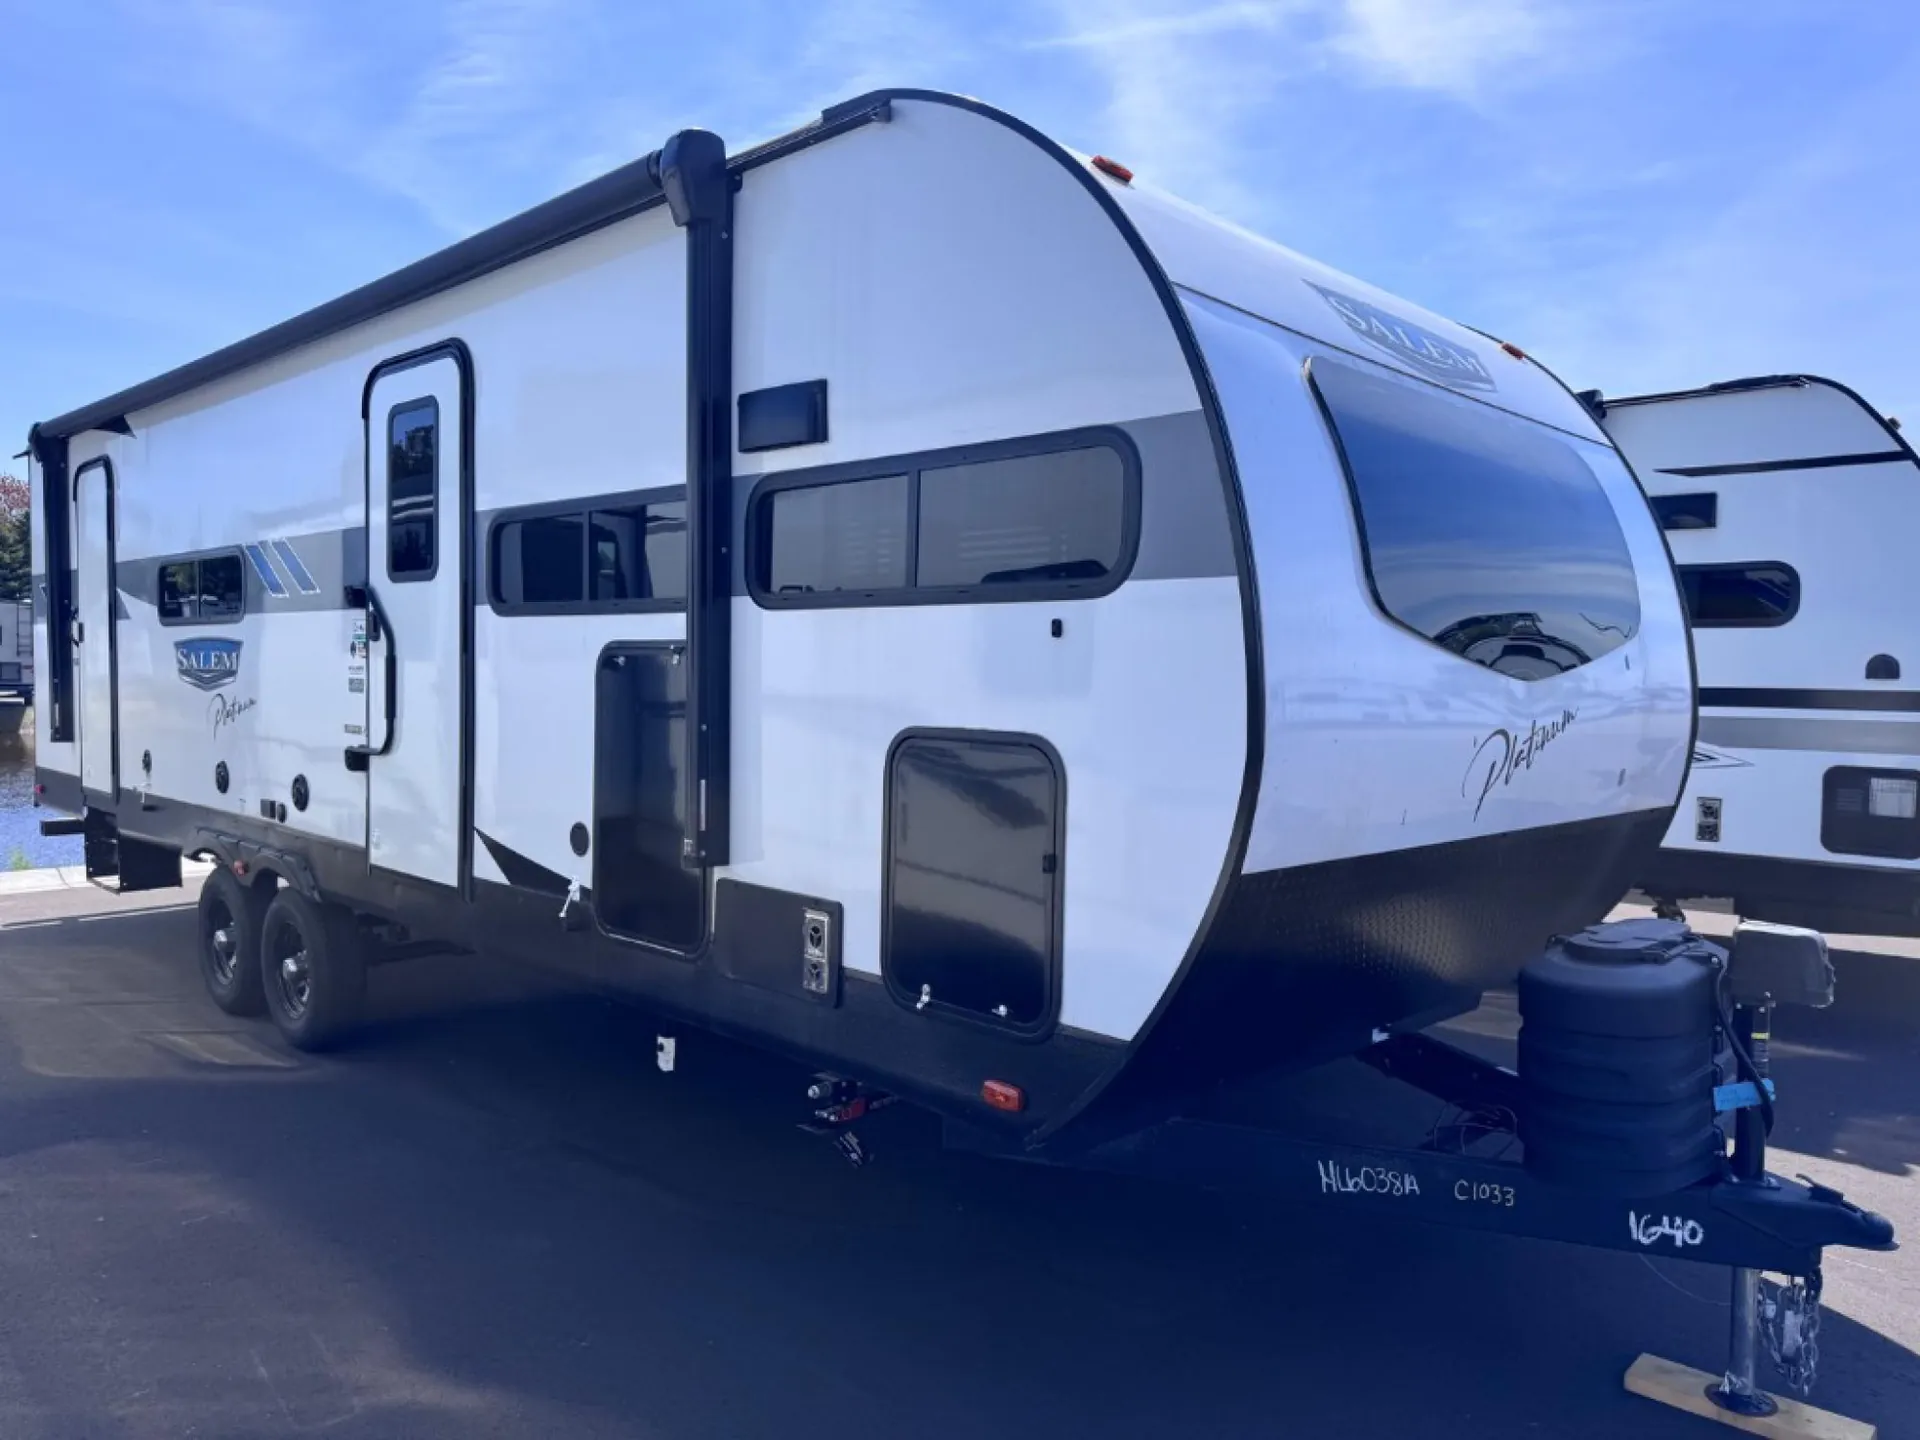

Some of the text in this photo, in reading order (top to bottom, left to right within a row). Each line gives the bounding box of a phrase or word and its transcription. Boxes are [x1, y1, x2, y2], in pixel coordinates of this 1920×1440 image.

[1333, 298, 1488, 378] SALEM
[177, 648, 239, 670] SALEM
[206, 693, 257, 741] Platinum
[1461, 706, 1580, 823] Platinum
[1454, 1179, 1516, 1207] C1033
[1629, 1210, 1704, 1248] 1640
